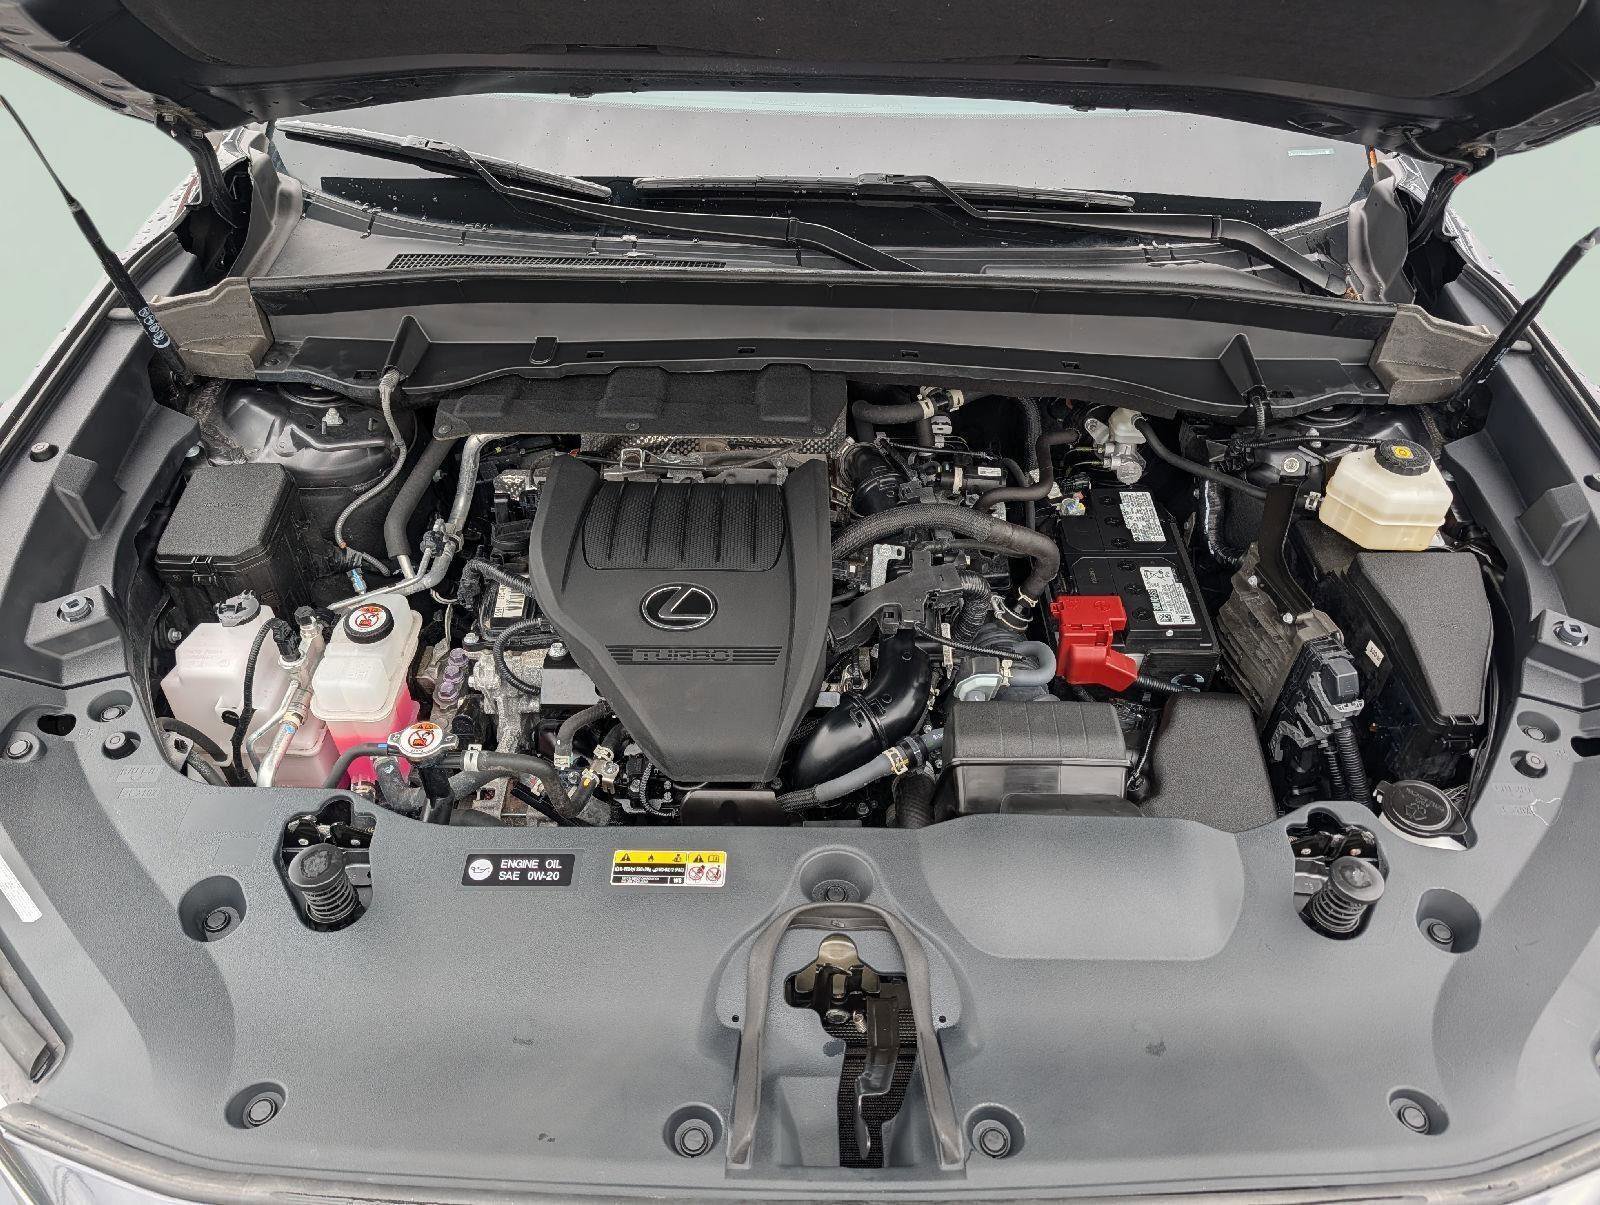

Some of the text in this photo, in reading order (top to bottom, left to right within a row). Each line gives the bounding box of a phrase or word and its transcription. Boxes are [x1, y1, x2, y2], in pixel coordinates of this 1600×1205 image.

[636, 649, 730, 662] TURBO
[500, 859, 563, 869] ENGINE OIL
[498, 871, 560, 881] SAE 0W-20
